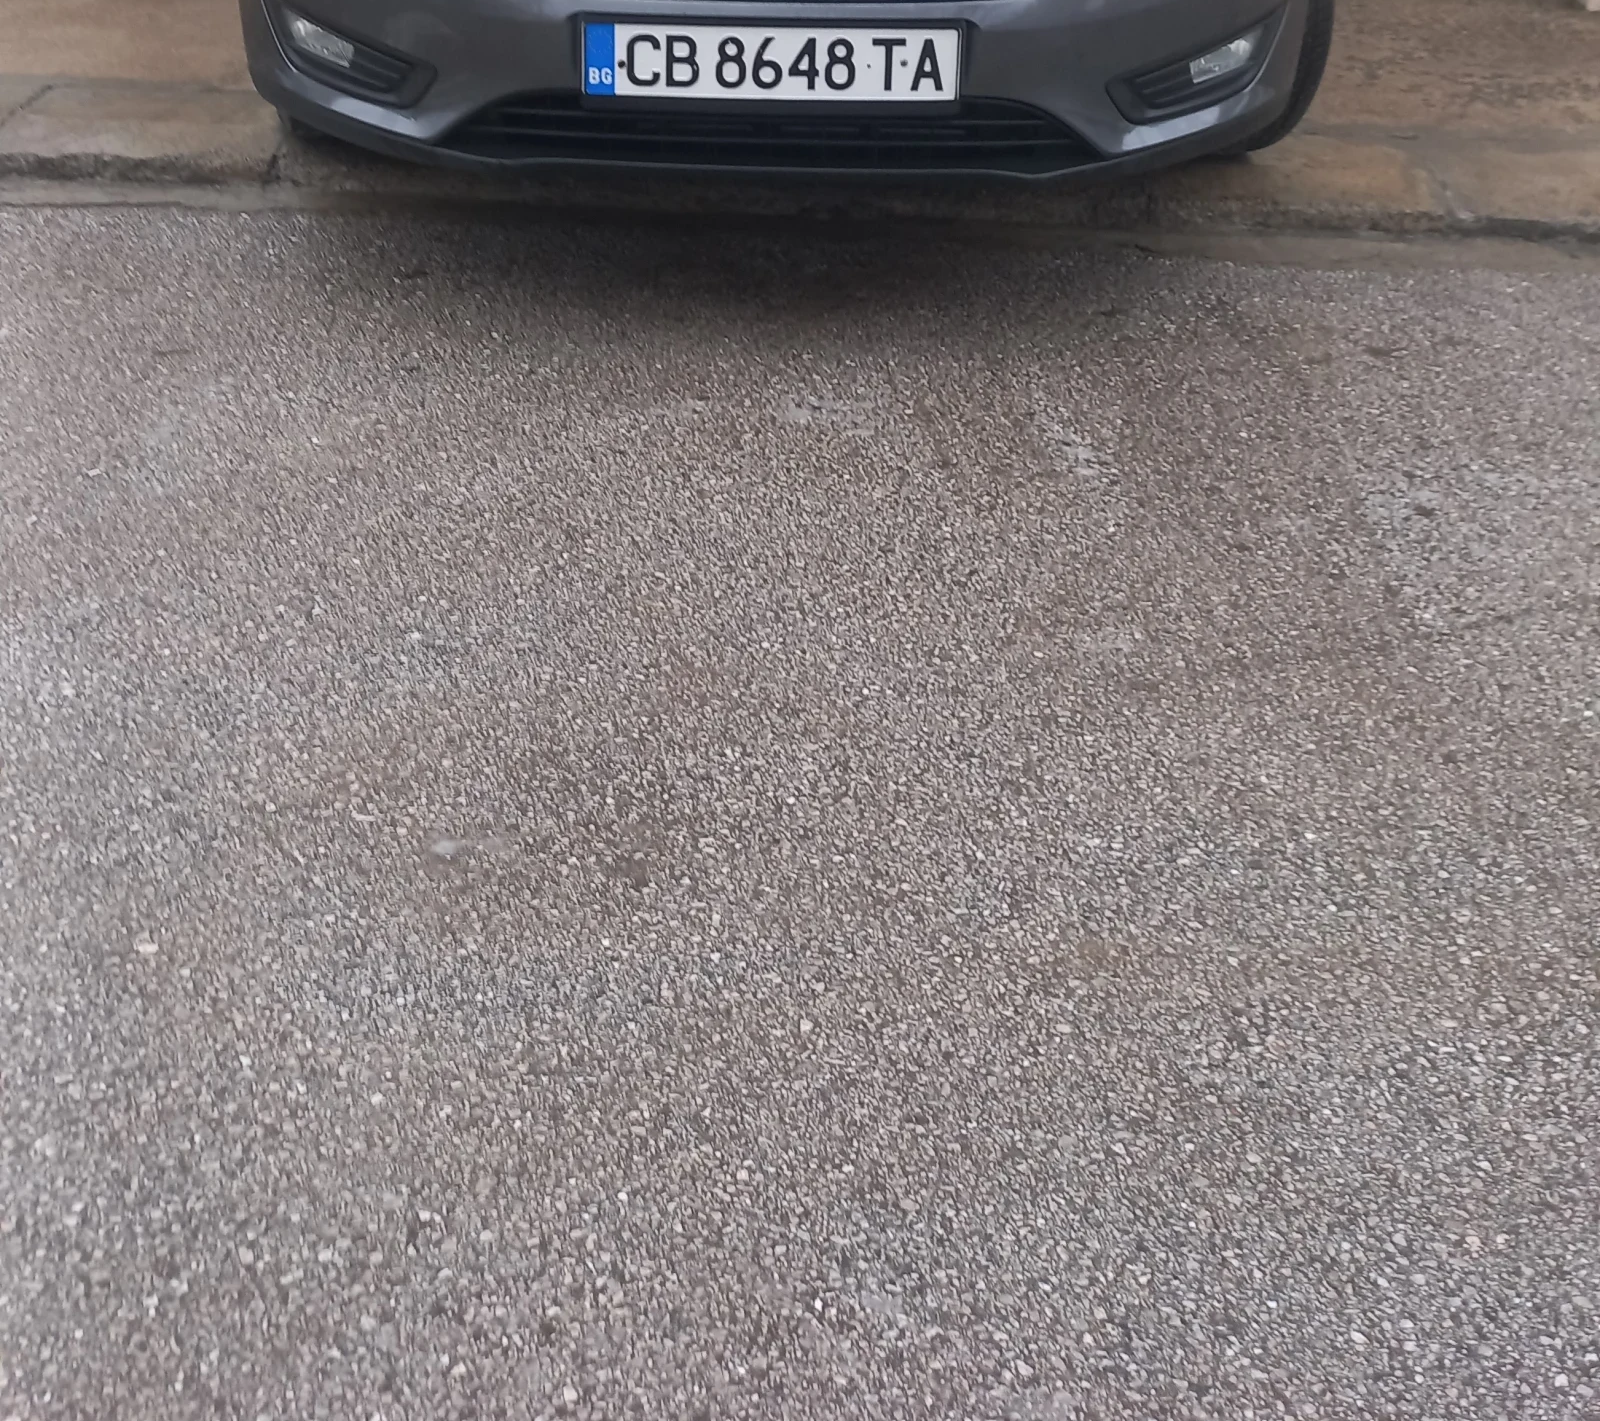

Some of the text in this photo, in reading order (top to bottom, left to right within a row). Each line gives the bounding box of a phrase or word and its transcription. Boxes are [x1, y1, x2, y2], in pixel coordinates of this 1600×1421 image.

[587, 66, 613, 85] BG
[625, 33, 944, 92] CB 8648 TA
